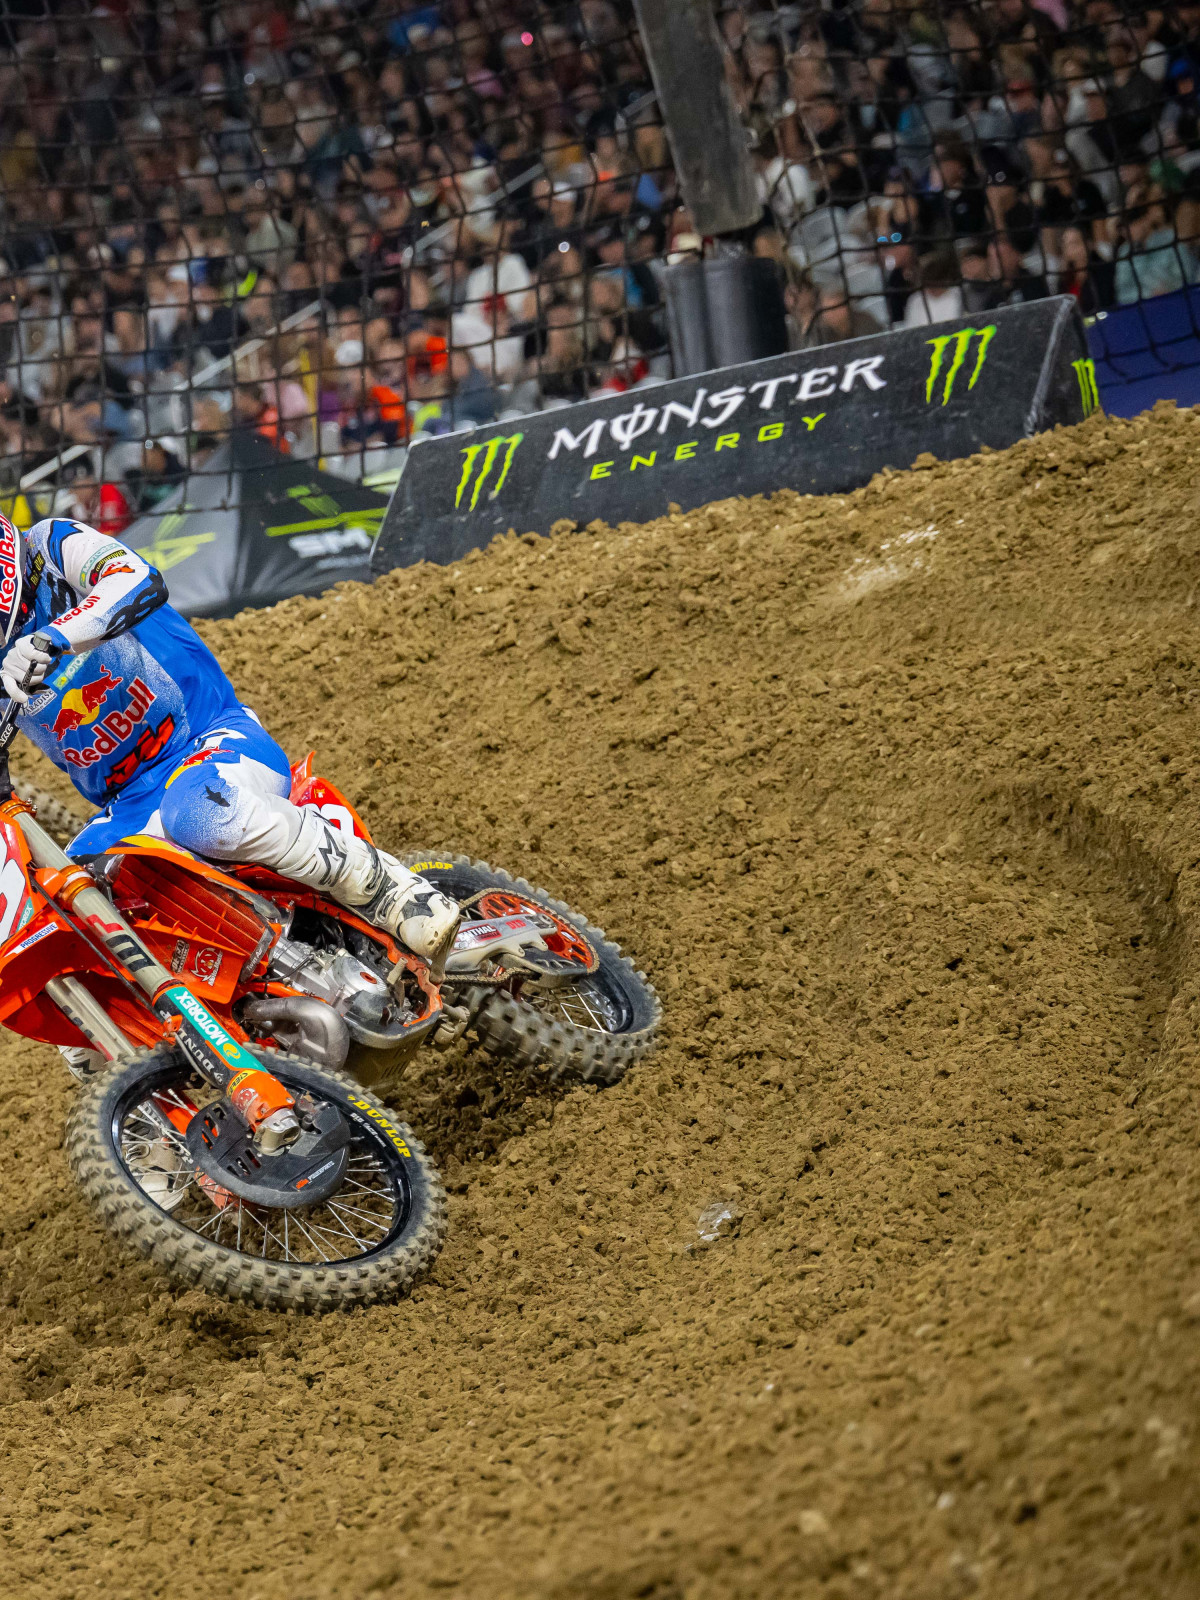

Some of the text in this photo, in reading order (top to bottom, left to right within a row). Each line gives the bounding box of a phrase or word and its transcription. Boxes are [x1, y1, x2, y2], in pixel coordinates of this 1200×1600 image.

[589, 412, 827, 481] ENERGY
[408, 861, 454, 874] DUNLOP
[19, 923, 58, 949] PROGRESSIVE
[159, 1010, 215, 1073] DUNLP
[175, 991, 230, 1046] MOTOREX
[352, 1100, 412, 1158] DUNLOP
